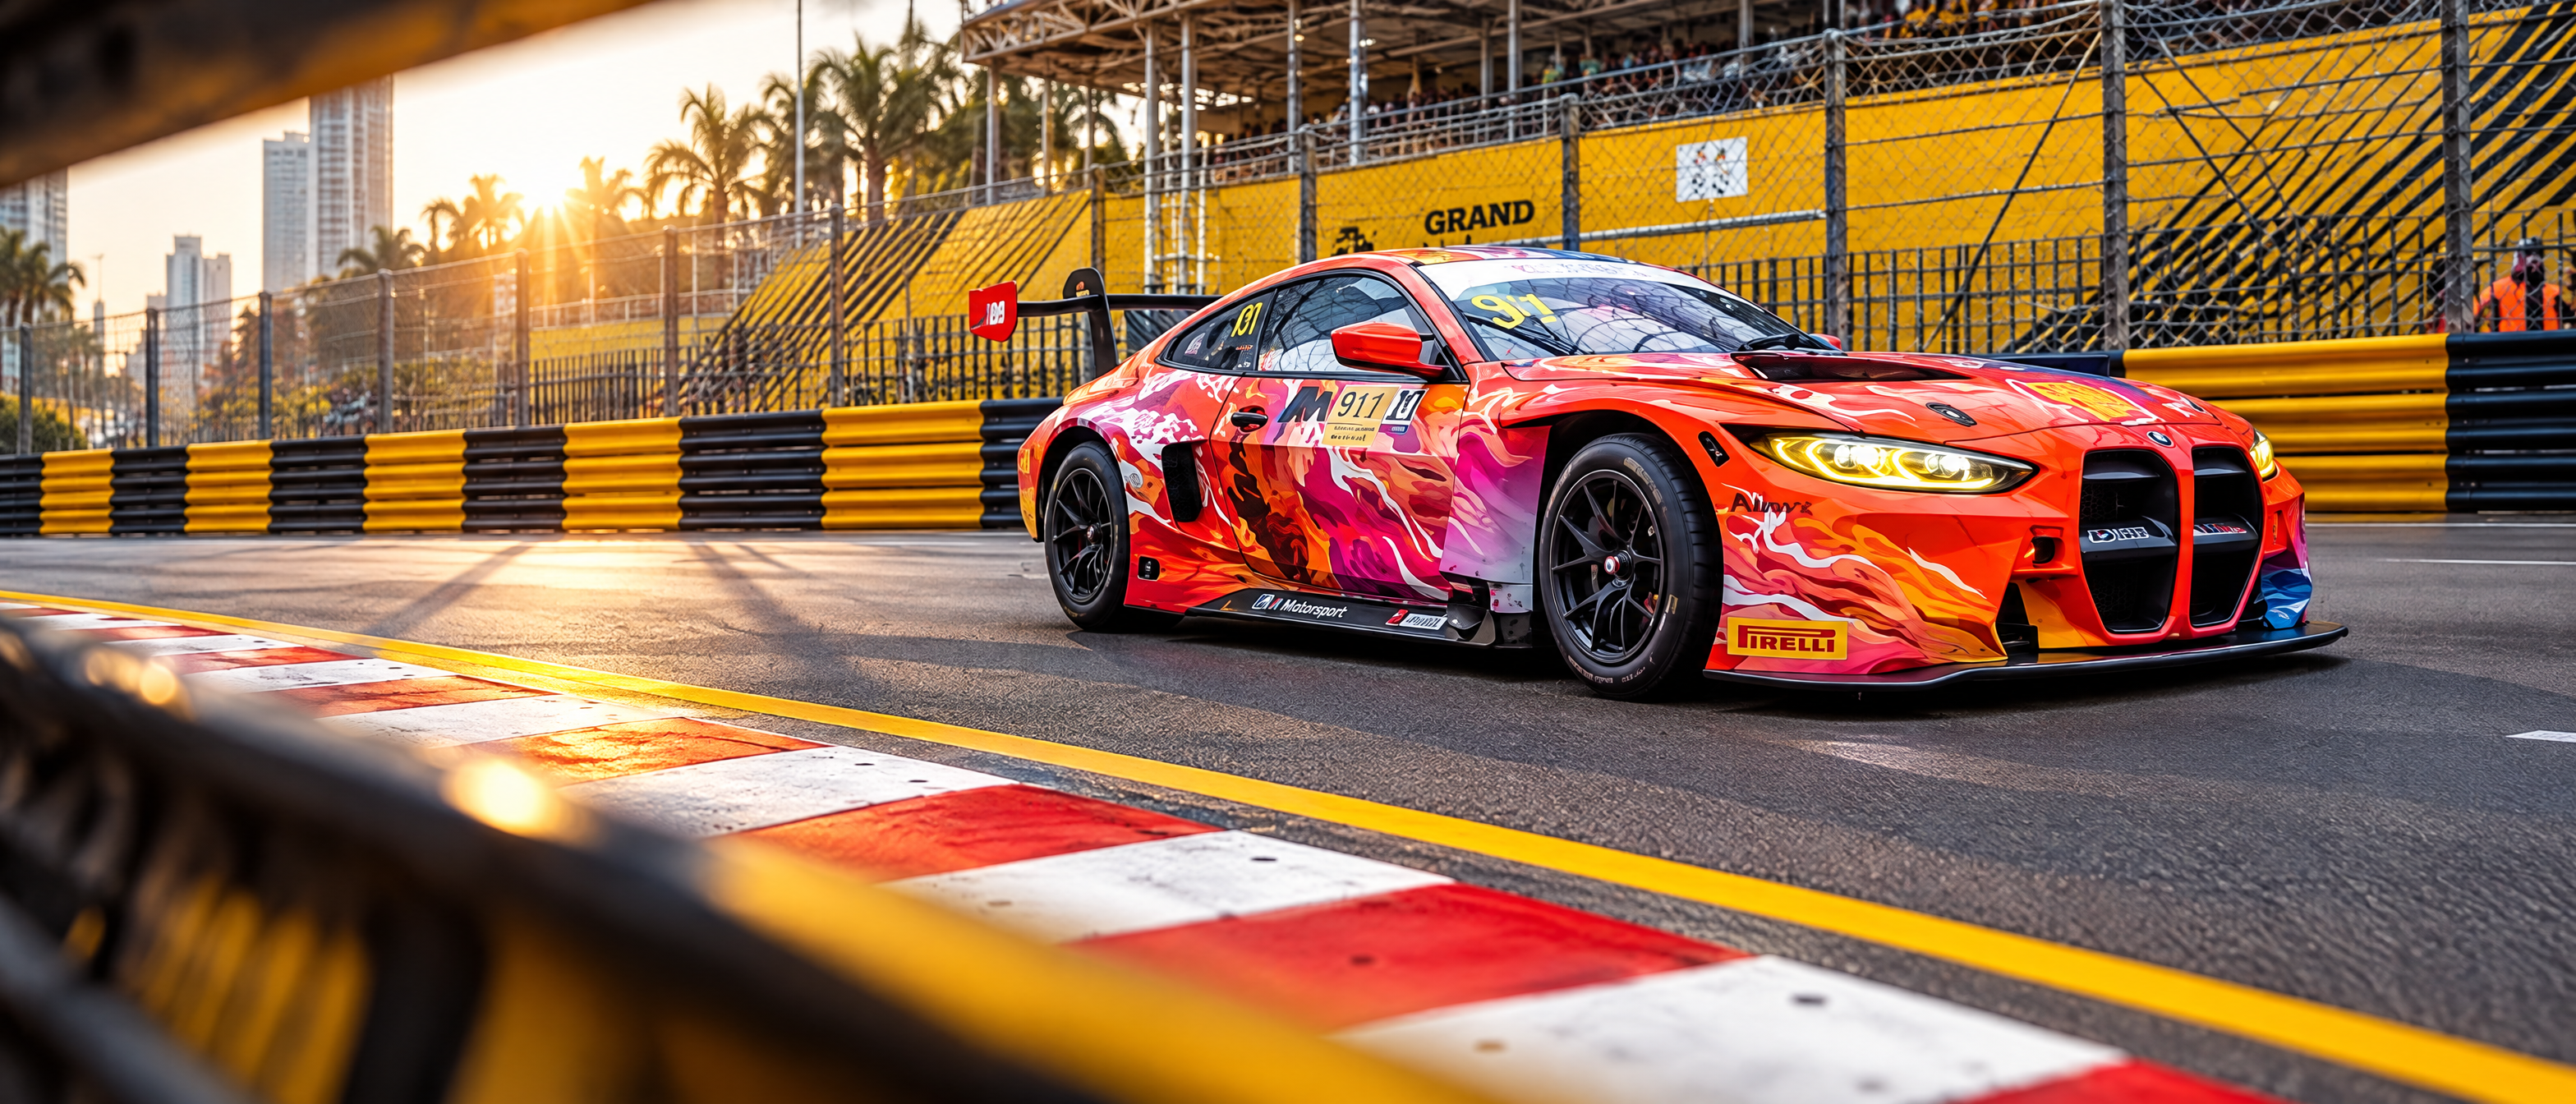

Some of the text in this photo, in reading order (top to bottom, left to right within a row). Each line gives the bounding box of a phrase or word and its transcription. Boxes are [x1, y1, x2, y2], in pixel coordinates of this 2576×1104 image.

[1424, 200, 1534, 236] GRAND
[1337, 391, 1385, 419] 911
[1280, 599, 1348, 619] Motorsport
[1737, 624, 1836, 653] PIRELLI
